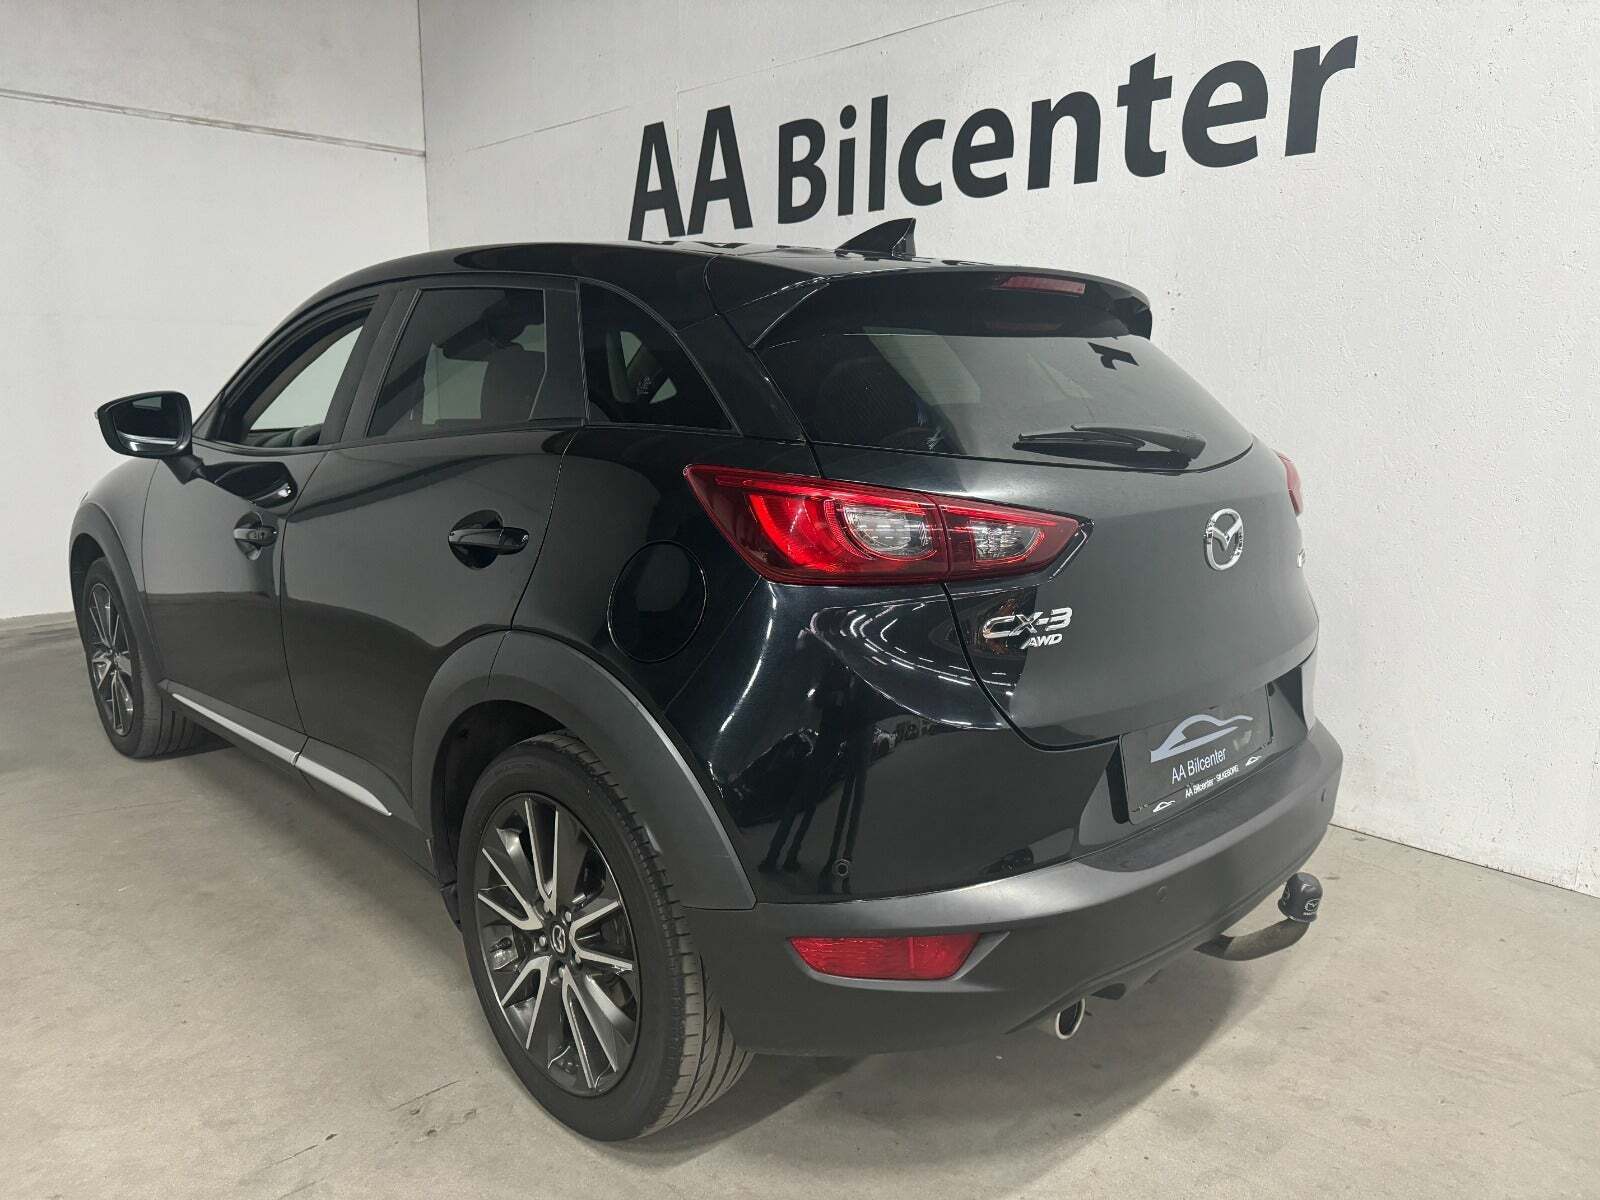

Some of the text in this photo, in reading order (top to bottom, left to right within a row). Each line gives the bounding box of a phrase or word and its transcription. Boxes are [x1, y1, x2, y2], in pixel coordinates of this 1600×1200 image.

[628, 35, 1358, 241] AA Bilcenter
[983, 607, 1073, 638] CX-3
[1020, 633, 1063, 650] AWD
[1172, 749, 1226, 784] AA Bilcenter
[1185, 787, 1194, 799] AA
[1194, 778, 1214, 794] Bilcenter
